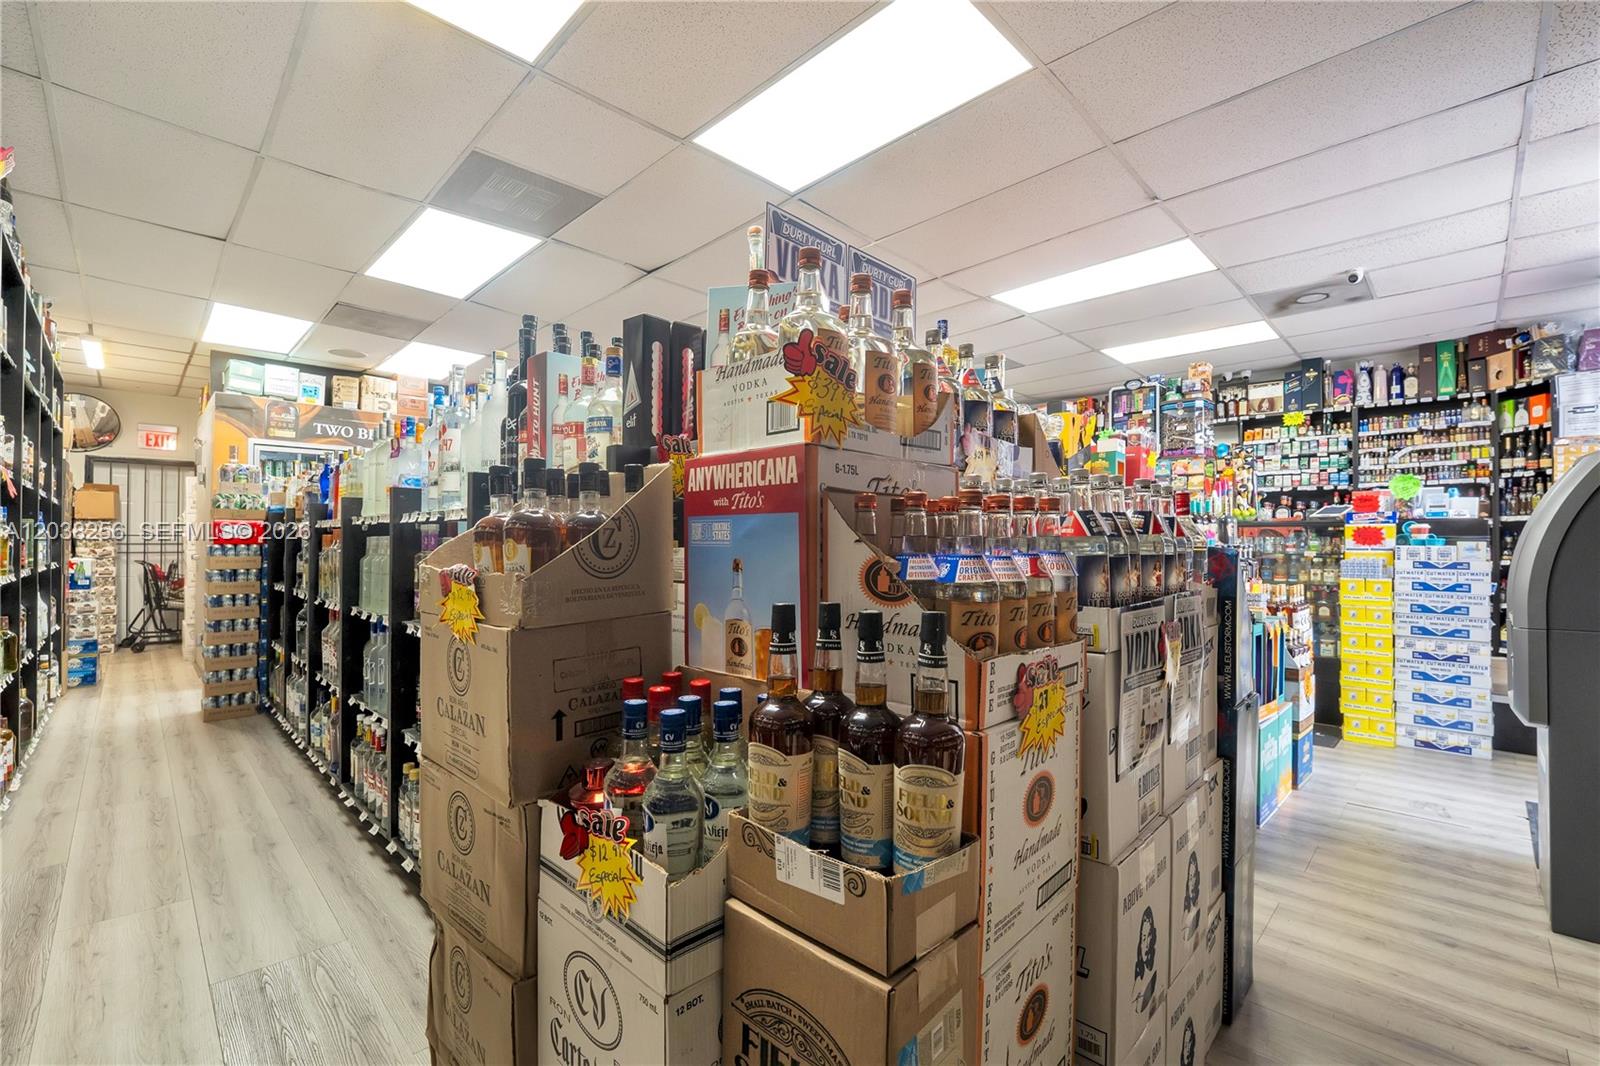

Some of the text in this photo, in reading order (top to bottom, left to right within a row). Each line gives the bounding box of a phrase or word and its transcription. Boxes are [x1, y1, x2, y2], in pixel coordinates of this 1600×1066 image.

[782, 222, 837, 259] DURTY GURL
[861, 262, 889, 284] DURTY
[715, 350, 784, 383] Handmade
[732, 377, 768, 393] VODKA
[145, 431, 170, 448] EXIT
[313, 422, 354, 439] TWO
[687, 455, 798, 492] ANYWHERICANA
[713, 490, 765, 509] with Tito's
[727, 622, 750, 637] Tito's
[1223, 600, 1233, 700] WWW.BLEUSTORM.COM
[437, 696, 487, 738] CALAZAN
[777, 778, 787, 787] &
[861, 786, 871, 795] &
[898, 787, 955, 809] FIELD &
[896, 801, 953, 823] SOUND
[589, 845, 609, 863] $12
[1013, 813, 1062, 873] Handmade
[1026, 853, 1052, 876] VODKA
[437, 849, 492, 908] CALAZAN
[588, 867, 626, 887] Especial
[1123, 881, 1144, 915] ABOVE
[985, 882, 993, 952] FREE
[1014, 943, 1053, 1004] Tito's
[549, 995, 571, 1024] RON
[638, 992, 650, 1007] 750
[675, 994, 705, 1017] 12 BOT.
[744, 999, 766, 1011] SMALL
[766, 1000, 794, 1018] BATCH
[798, 1015, 825, 1043] SWEET
